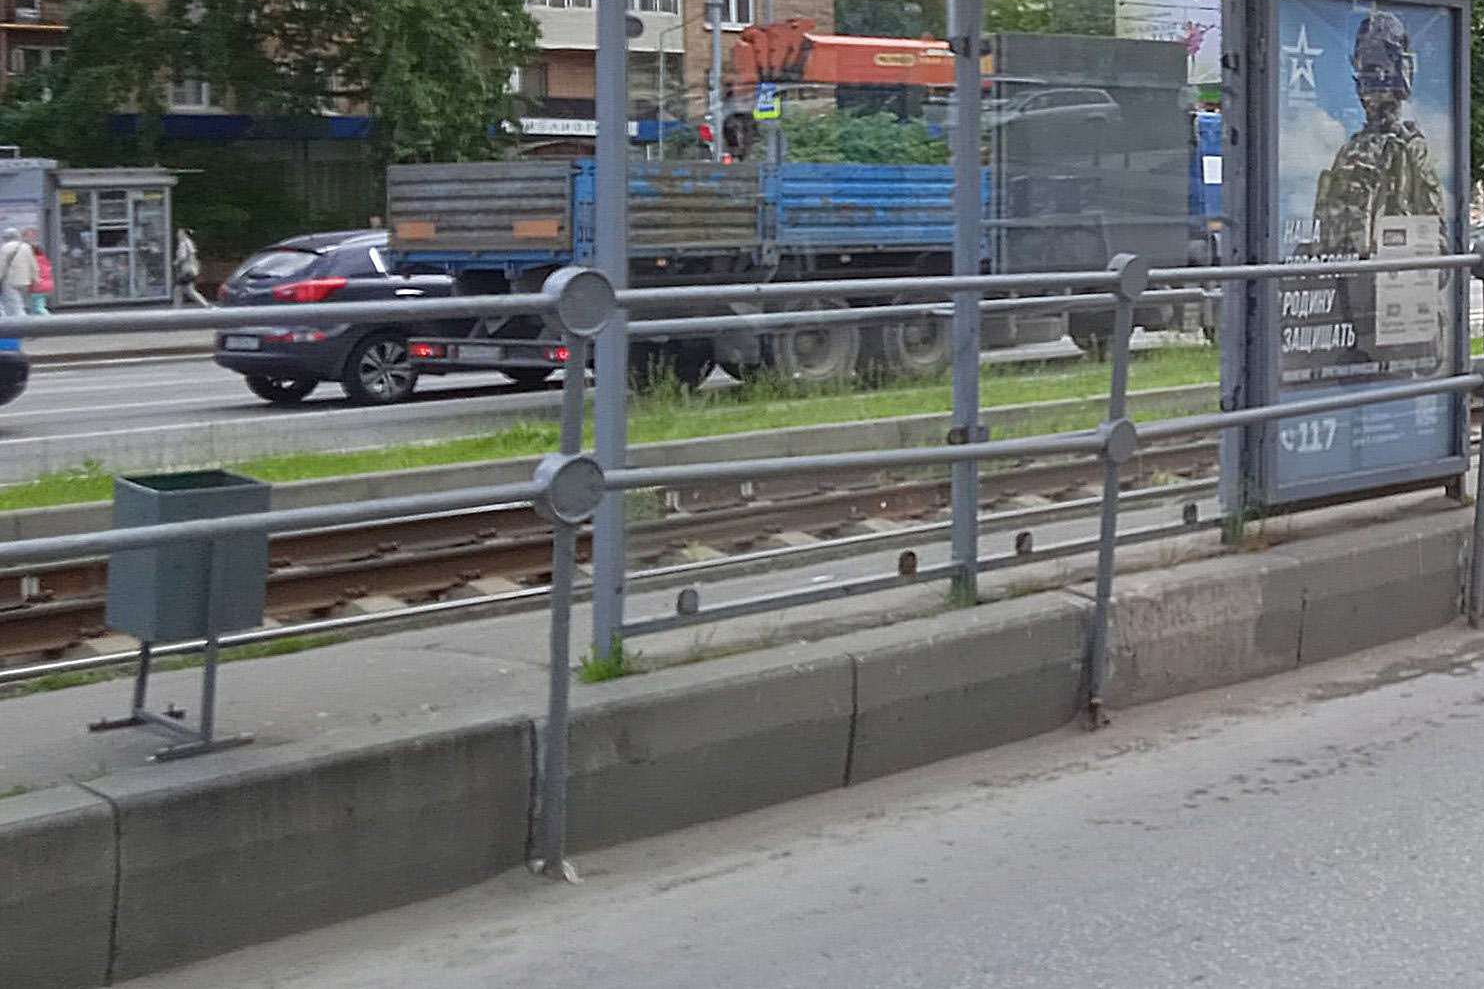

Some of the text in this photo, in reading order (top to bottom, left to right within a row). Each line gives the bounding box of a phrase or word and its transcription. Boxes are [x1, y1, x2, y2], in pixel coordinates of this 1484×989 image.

[1284, 219, 1321, 245] НАША
[1282, 288, 1336, 318] РОДИНУ
[1282, 322, 1356, 353] ЗАЩИЩАТЬ
[1297, 417, 1337, 452] 117
